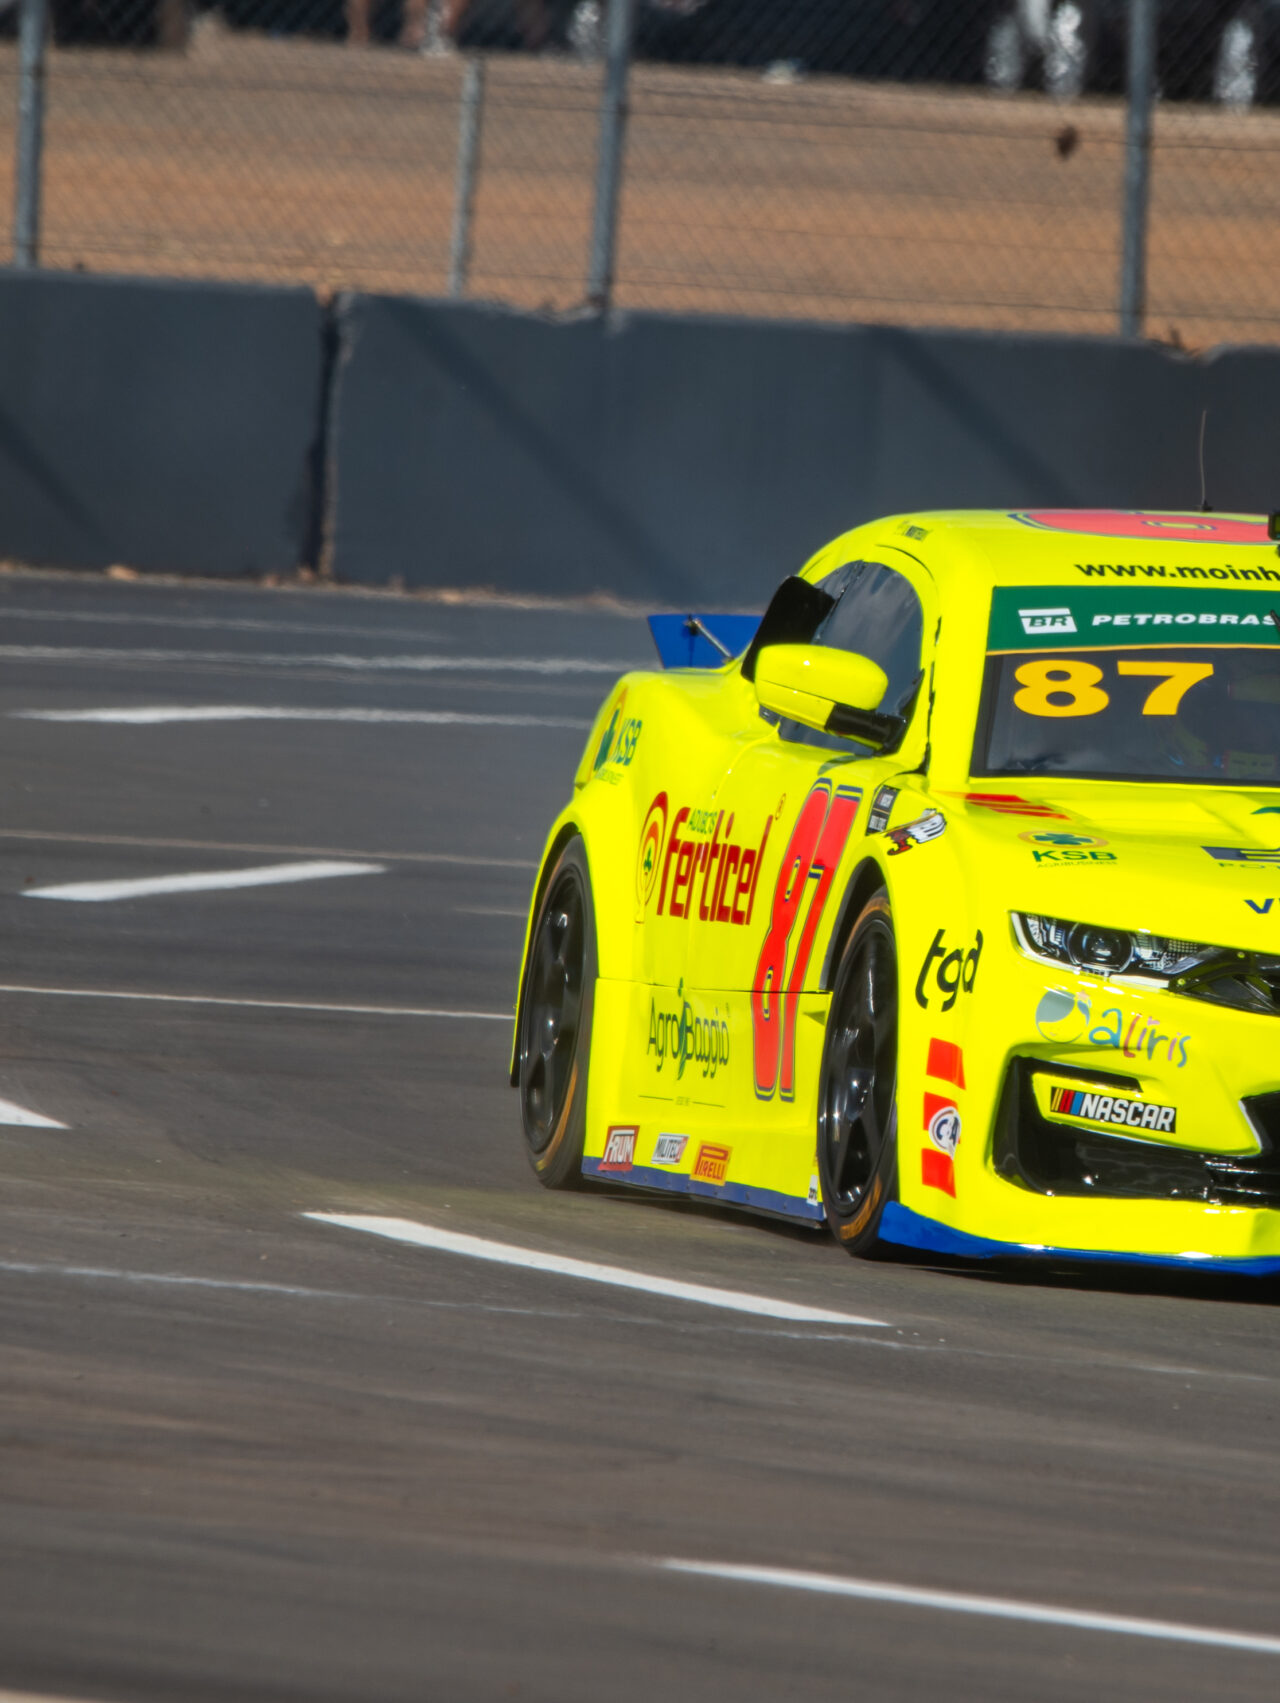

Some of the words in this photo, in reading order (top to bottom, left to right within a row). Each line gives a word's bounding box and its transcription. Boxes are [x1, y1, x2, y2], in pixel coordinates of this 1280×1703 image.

[1091, 612, 1278, 627] PETROBRAS
[1012, 659, 1214, 718] 87
[1031, 850, 1119, 862] KSB
[751, 777, 864, 1103] 87
[915, 928, 984, 1013] tgd
[1079, 1093, 1175, 1132] NASCAR
[694, 1144, 729, 1181] PIRELLI
